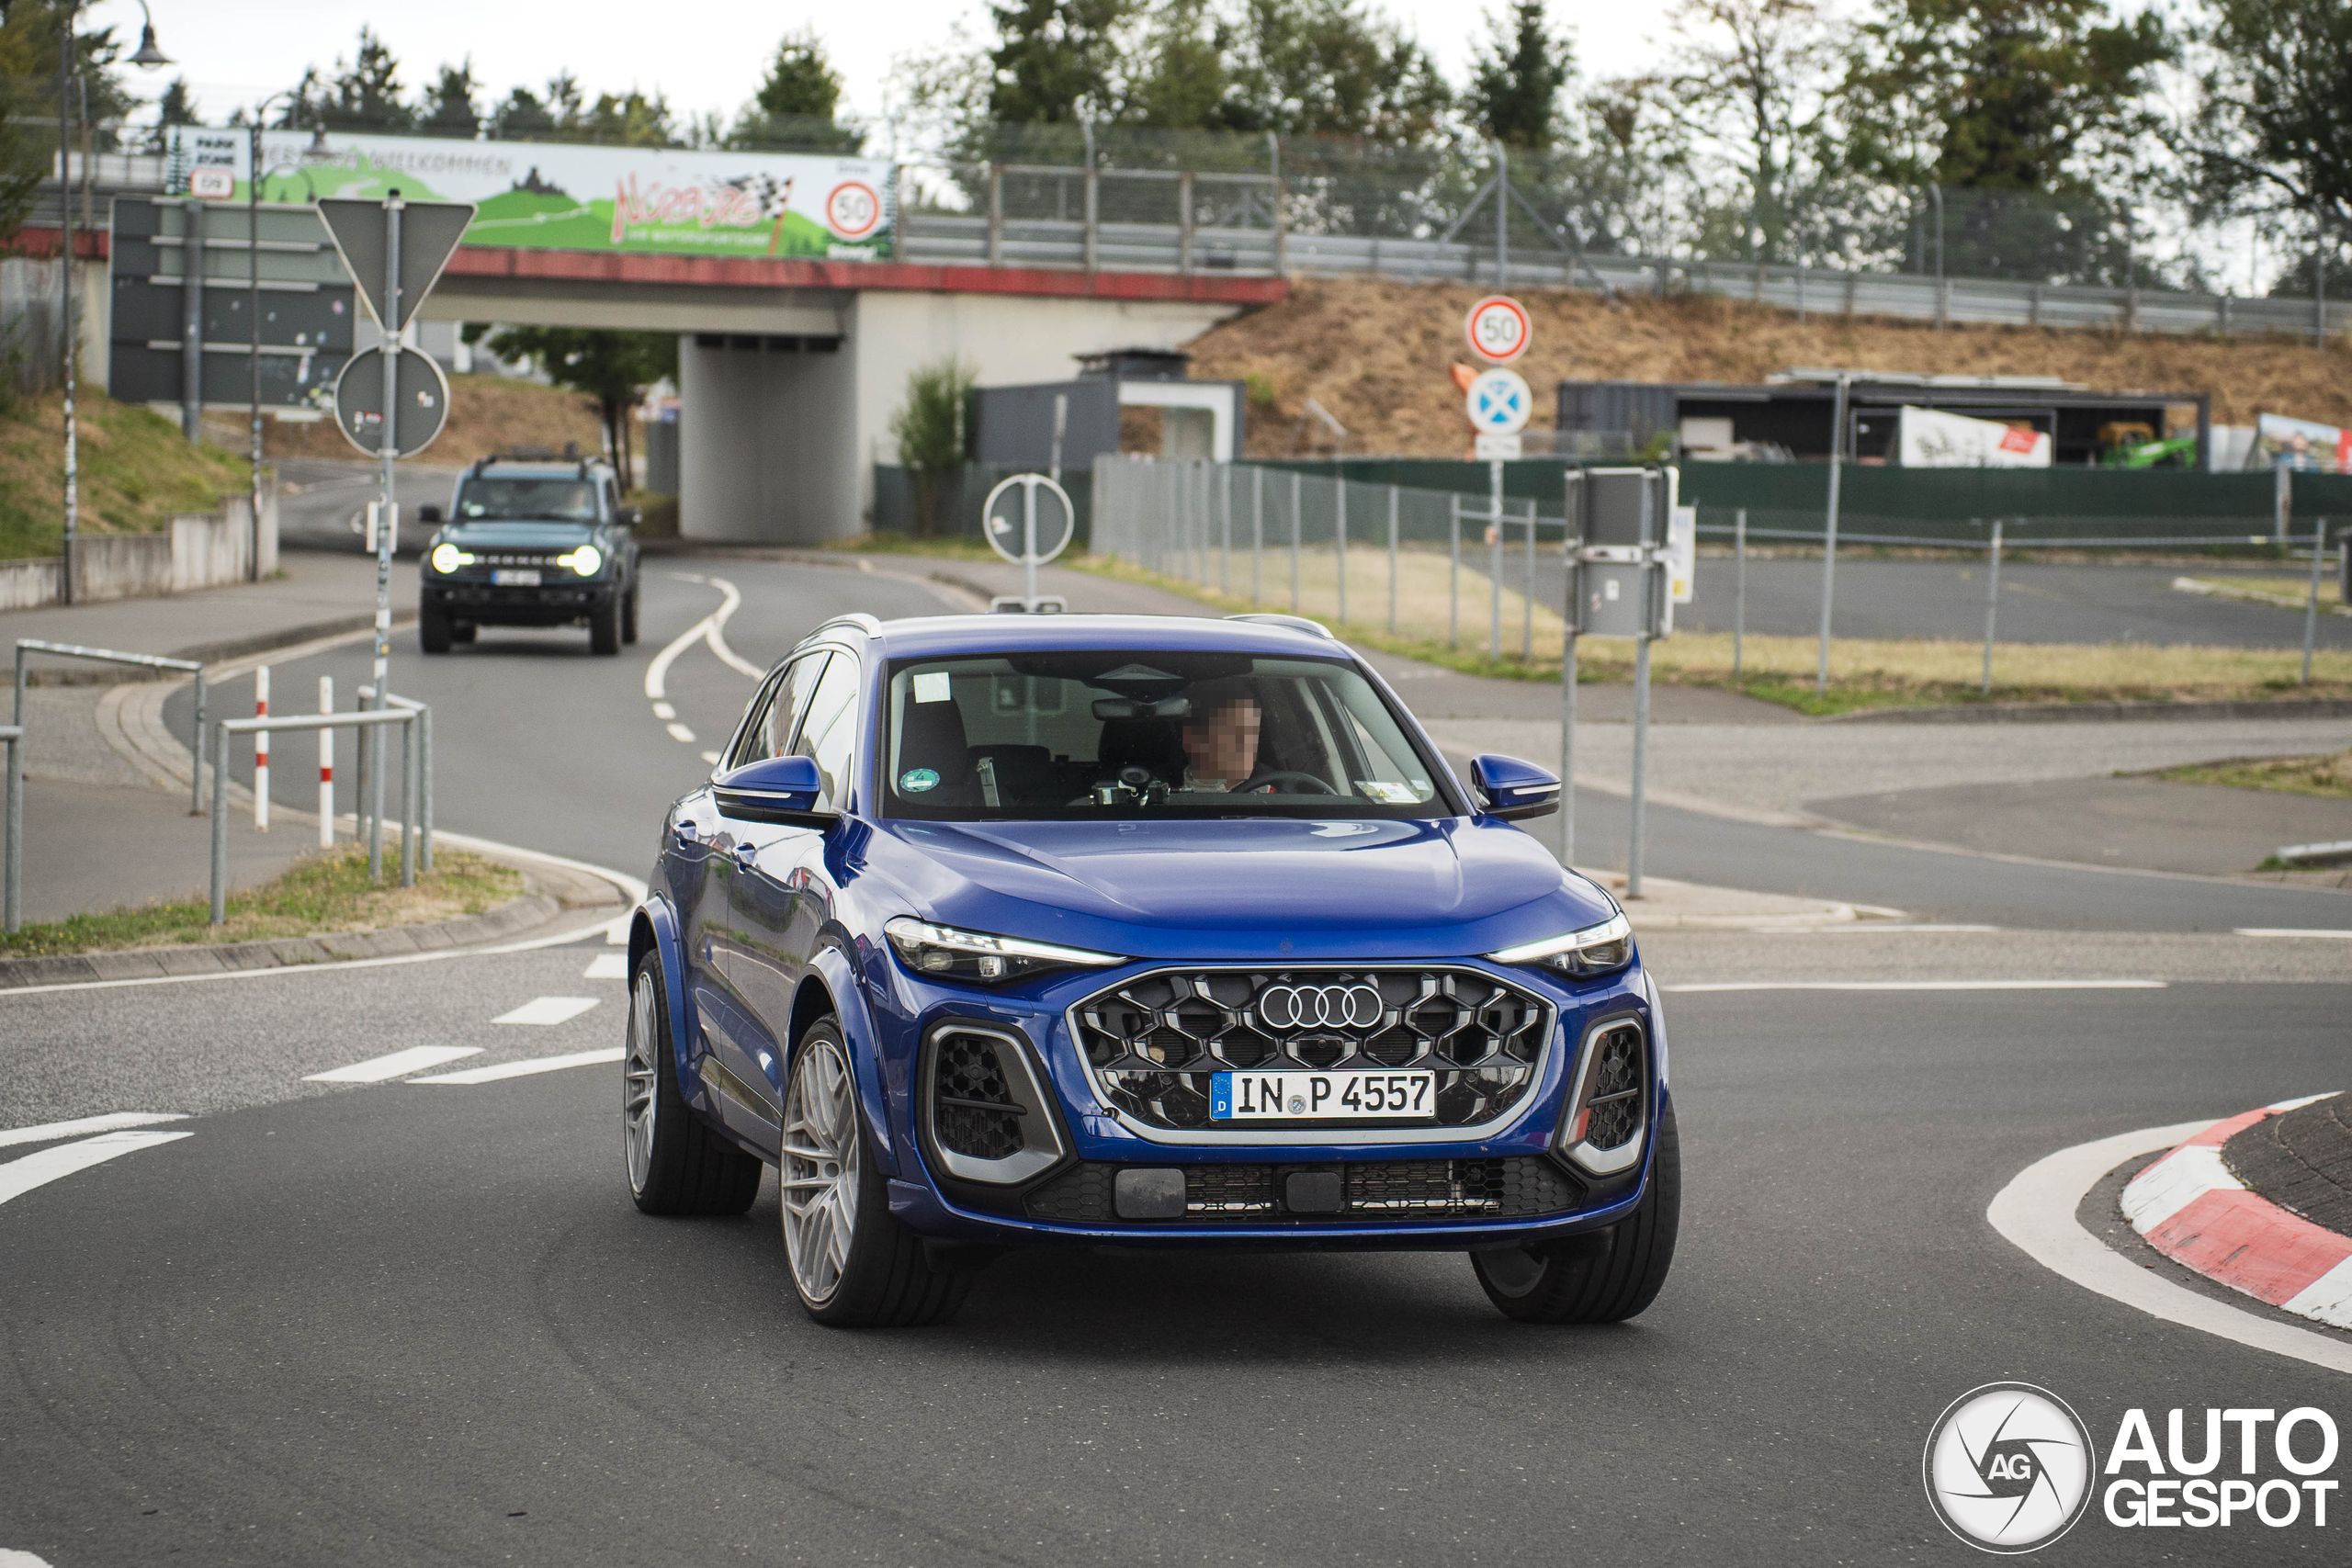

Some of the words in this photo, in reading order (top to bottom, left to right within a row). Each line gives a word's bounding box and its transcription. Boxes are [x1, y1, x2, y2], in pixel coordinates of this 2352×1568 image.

[838, 195, 868, 220] 50
[1483, 315, 1515, 343] 50
[915, 772, 925, 781] 4
[1217, 1100, 1227, 1111] D
[1238, 1077, 1283, 1113] IN
[1309, 1077, 1332, 1112] P
[1340, 1076, 1430, 1112] 4557
